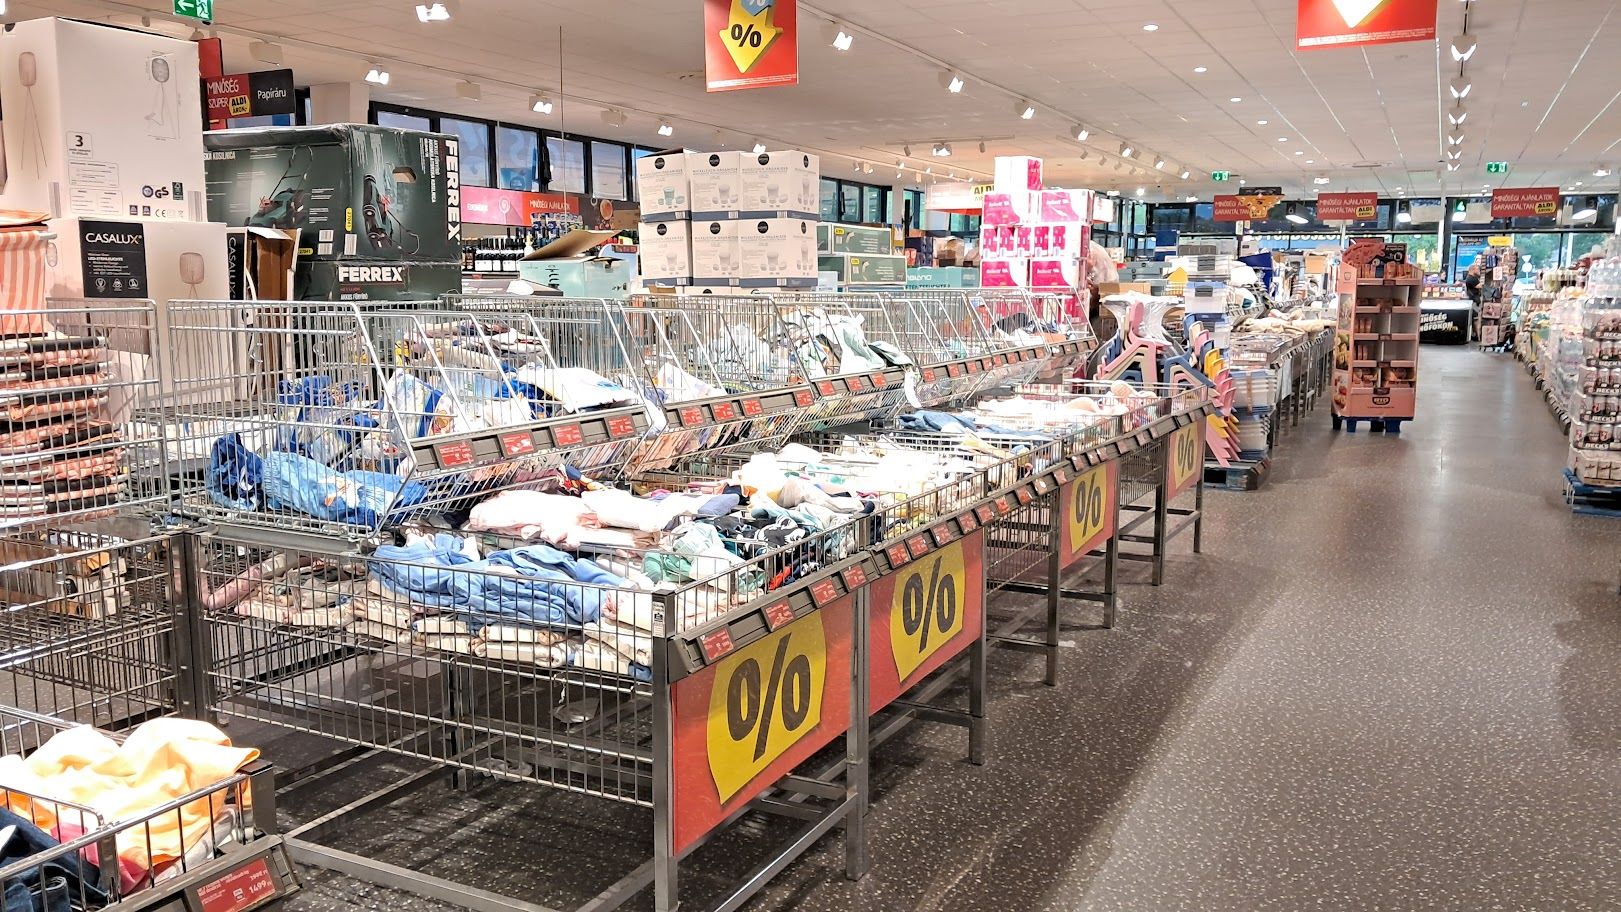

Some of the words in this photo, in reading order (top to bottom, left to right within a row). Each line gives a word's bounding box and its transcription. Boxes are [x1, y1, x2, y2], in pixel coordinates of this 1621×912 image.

[207, 78, 239, 95] MINŐSÉG
[257, 87, 287, 101] Papíráru
[208, 97, 229, 108] SZUPER
[231, 96, 247, 106] ALDI
[75, 135, 84, 147] 3
[154, 186, 169, 198] GS
[445, 139, 460, 241] FERREX
[85, 232, 139, 244] CASALUX
[228, 236, 237, 296] CASALUX
[338, 266, 403, 282] FERREX
[249, 880, 266, 893] 1499
